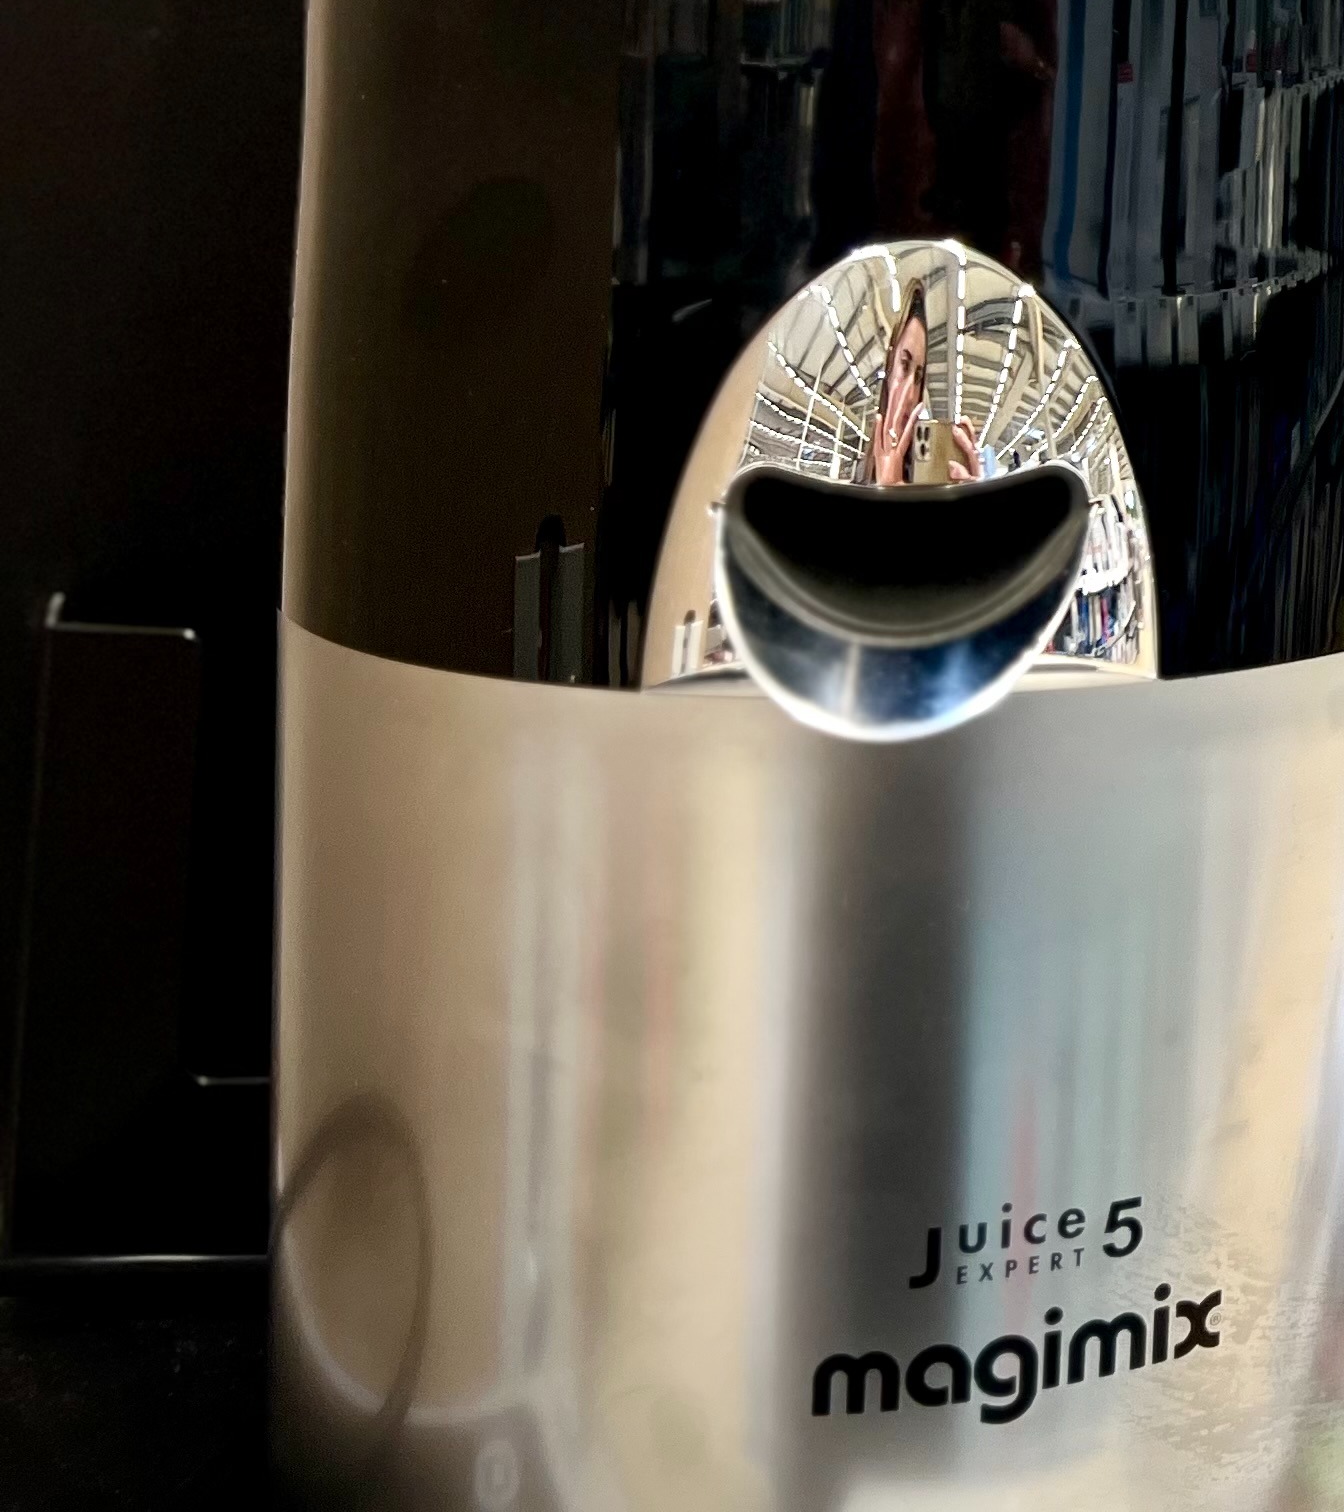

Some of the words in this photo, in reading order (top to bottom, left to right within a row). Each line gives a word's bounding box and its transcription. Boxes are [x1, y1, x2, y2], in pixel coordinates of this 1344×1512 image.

[908, 1202, 1086, 1289] Juice
[1102, 1196, 1144, 1258] 5
[956, 1247, 1085, 1286] EXPERT
[811, 1282, 1223, 1425] magimix
